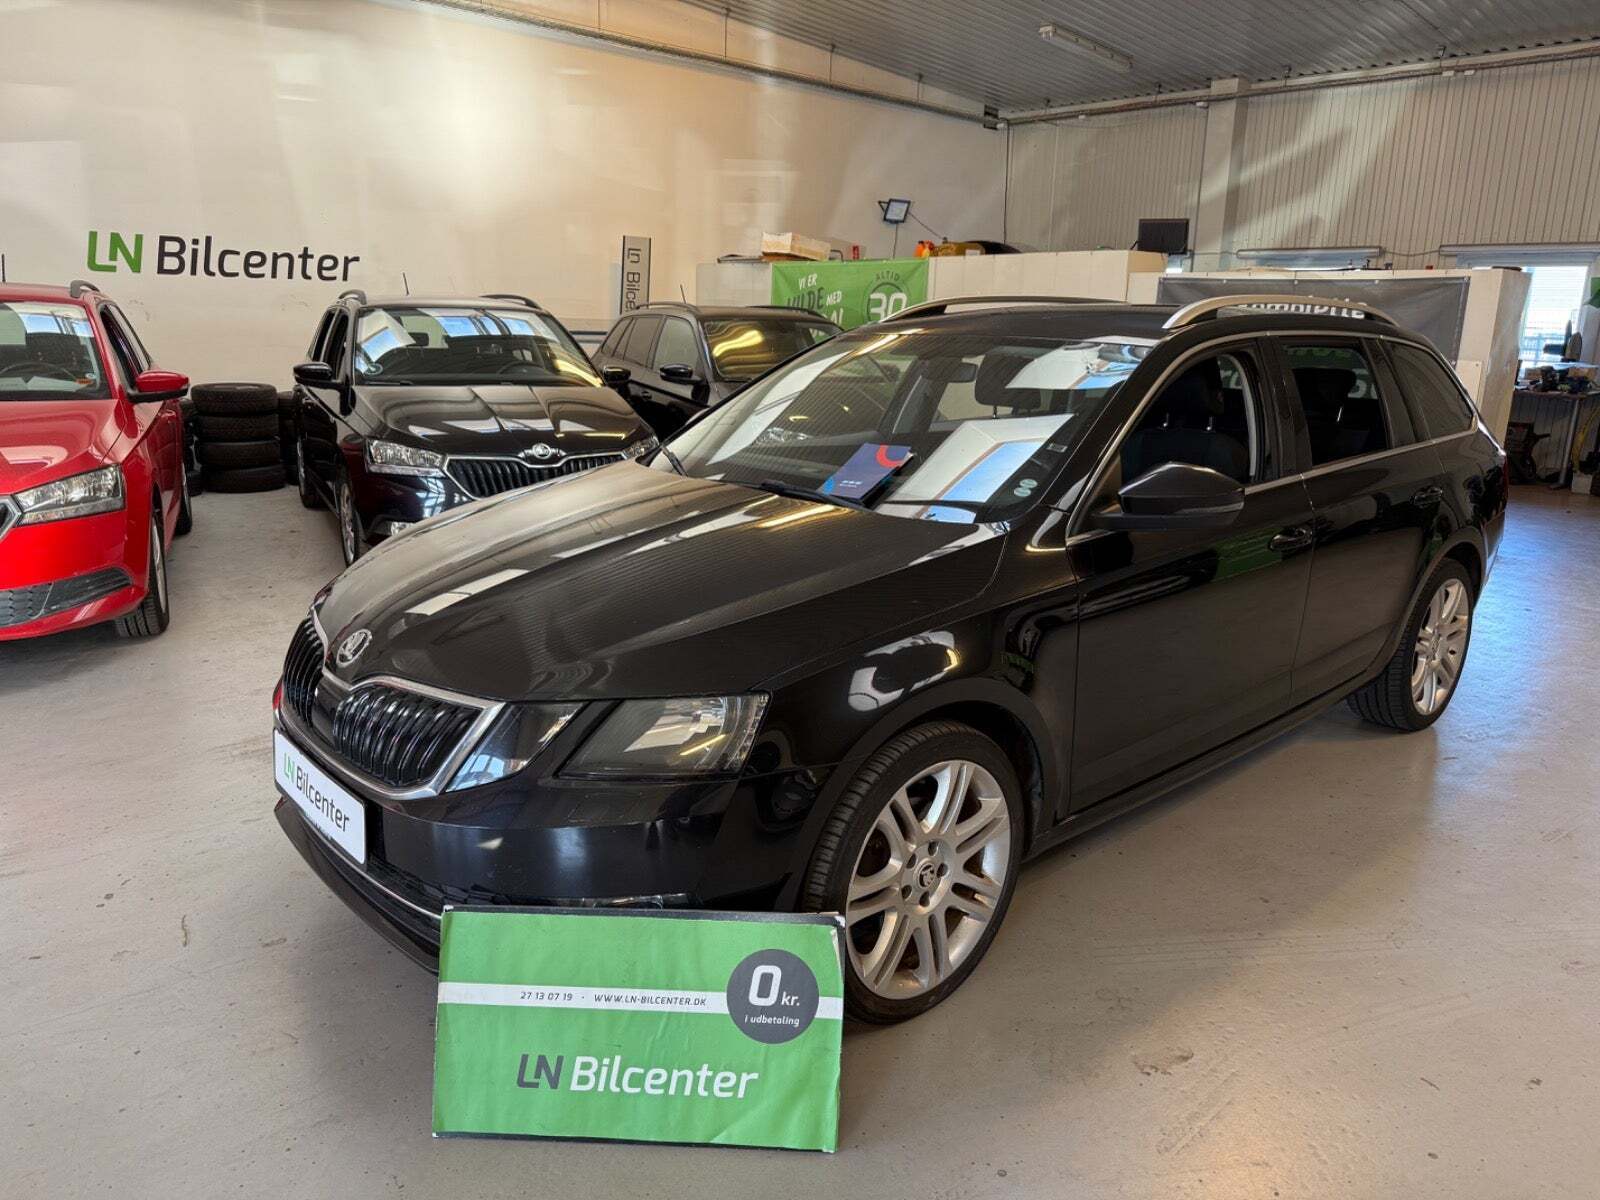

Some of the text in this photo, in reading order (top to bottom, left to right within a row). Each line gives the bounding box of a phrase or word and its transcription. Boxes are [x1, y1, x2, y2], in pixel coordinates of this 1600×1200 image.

[87, 231, 360, 281] LN Bilcenter
[625, 272, 640, 312] Bilce
[807, 273, 818, 287] ER
[296, 766, 350, 832] Bilcenter
[520, 991, 707, 1006] 27 13 07 19 WWW.LN-BILCENTER.DK
[748, 965, 800, 1007] 0 kr.
[750, 1014, 800, 1028] udbetaling
[516, 1054, 759, 1099] LN Bilcenter
